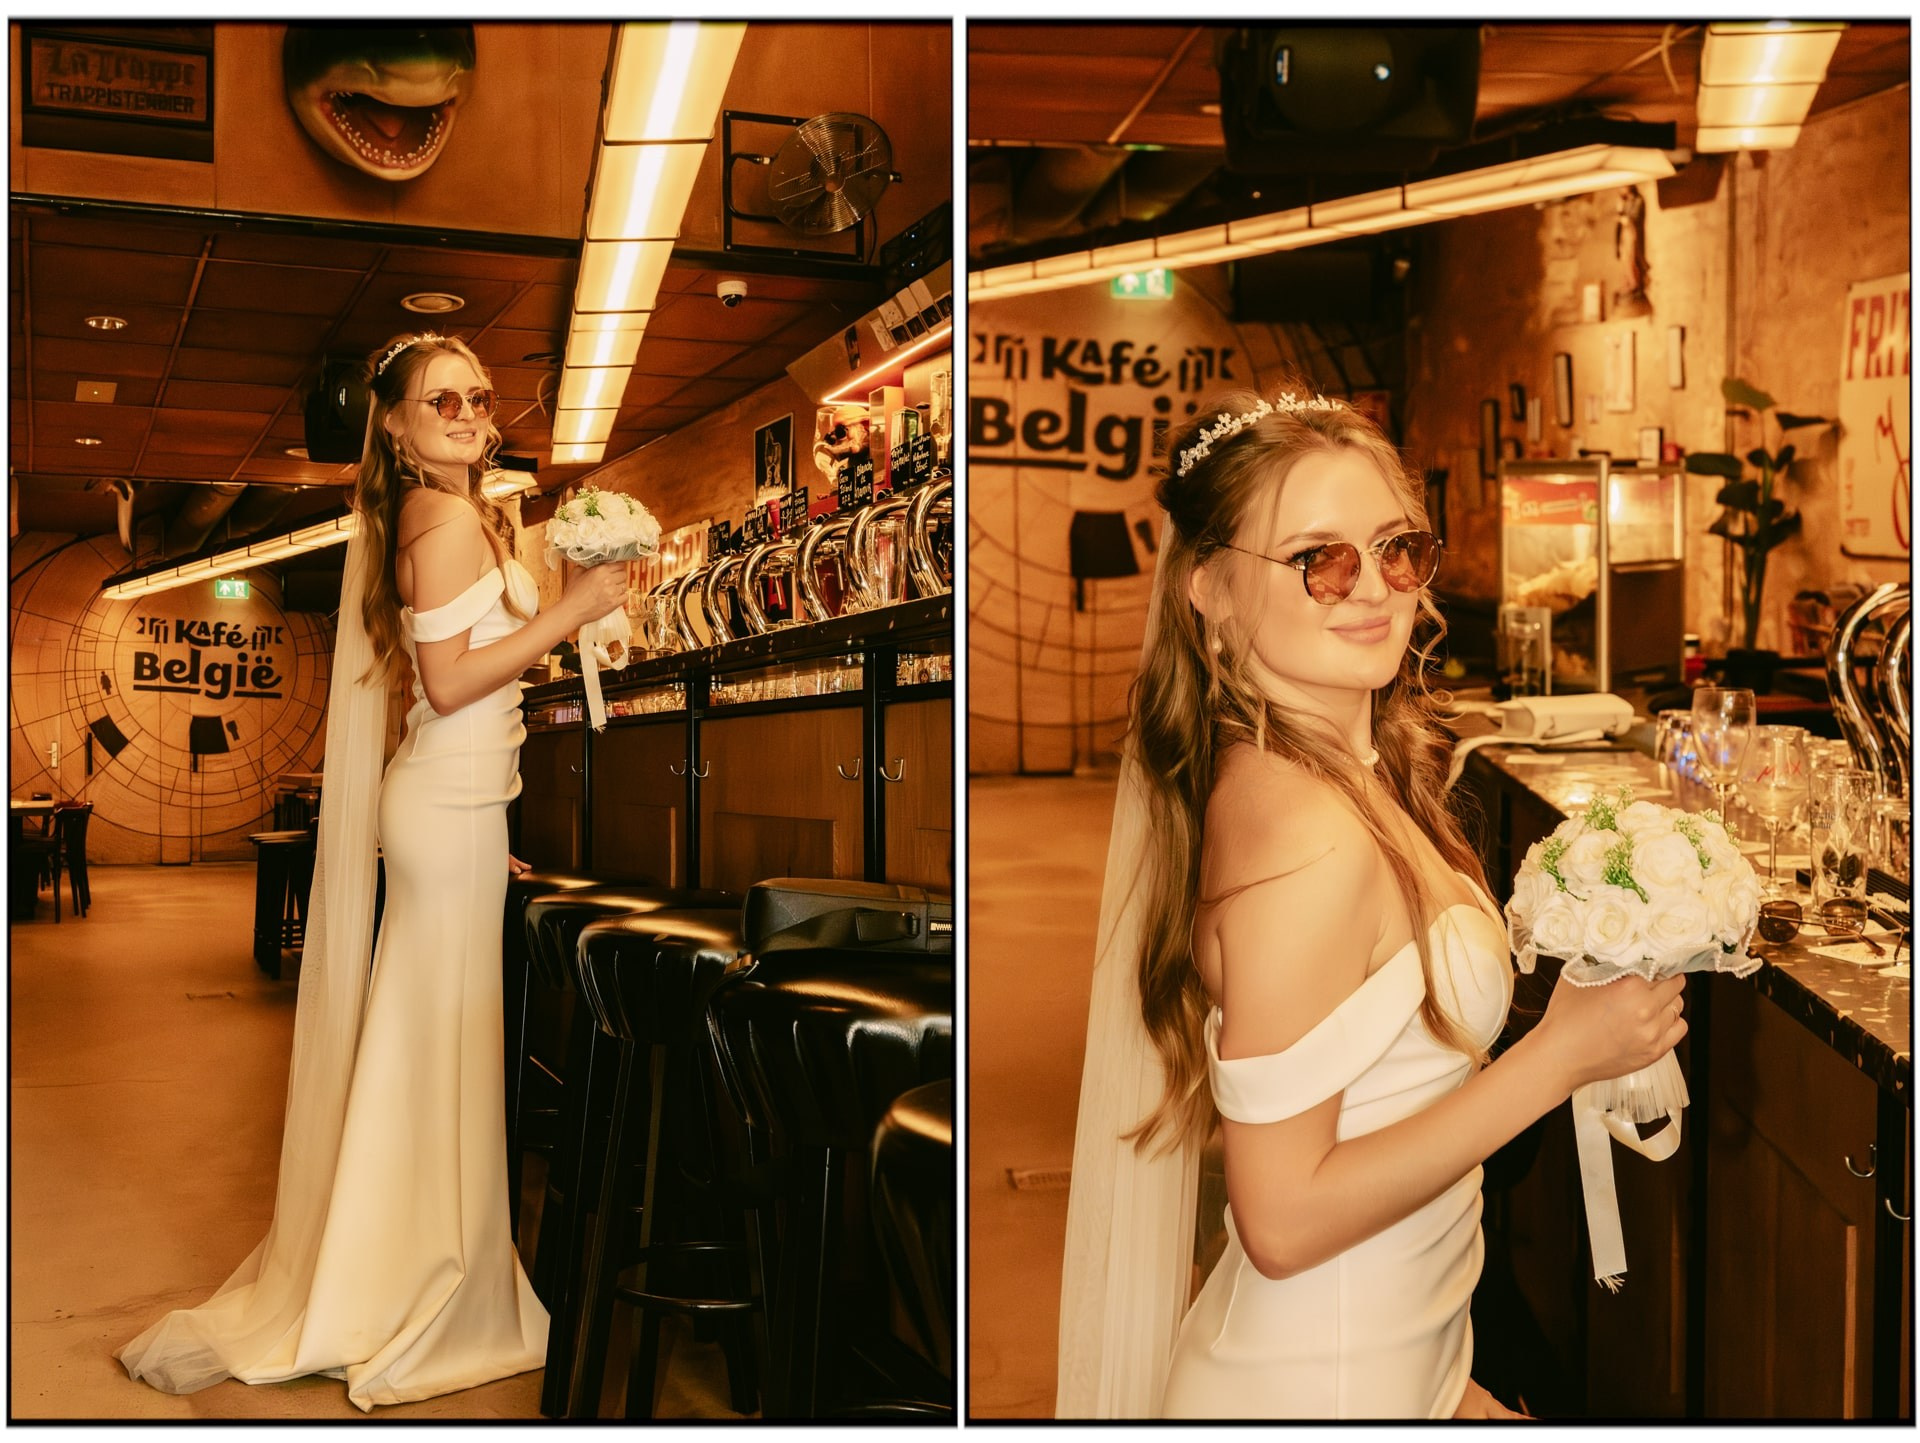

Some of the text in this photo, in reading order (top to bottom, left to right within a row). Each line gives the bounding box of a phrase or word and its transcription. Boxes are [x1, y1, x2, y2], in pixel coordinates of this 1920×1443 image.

[91, 48, 195, 90] Trappe
[45, 82, 195, 113] TRAPPISTENBIER
[969, 388, 1198, 481] Belgi
[134, 648, 282, 700] België
